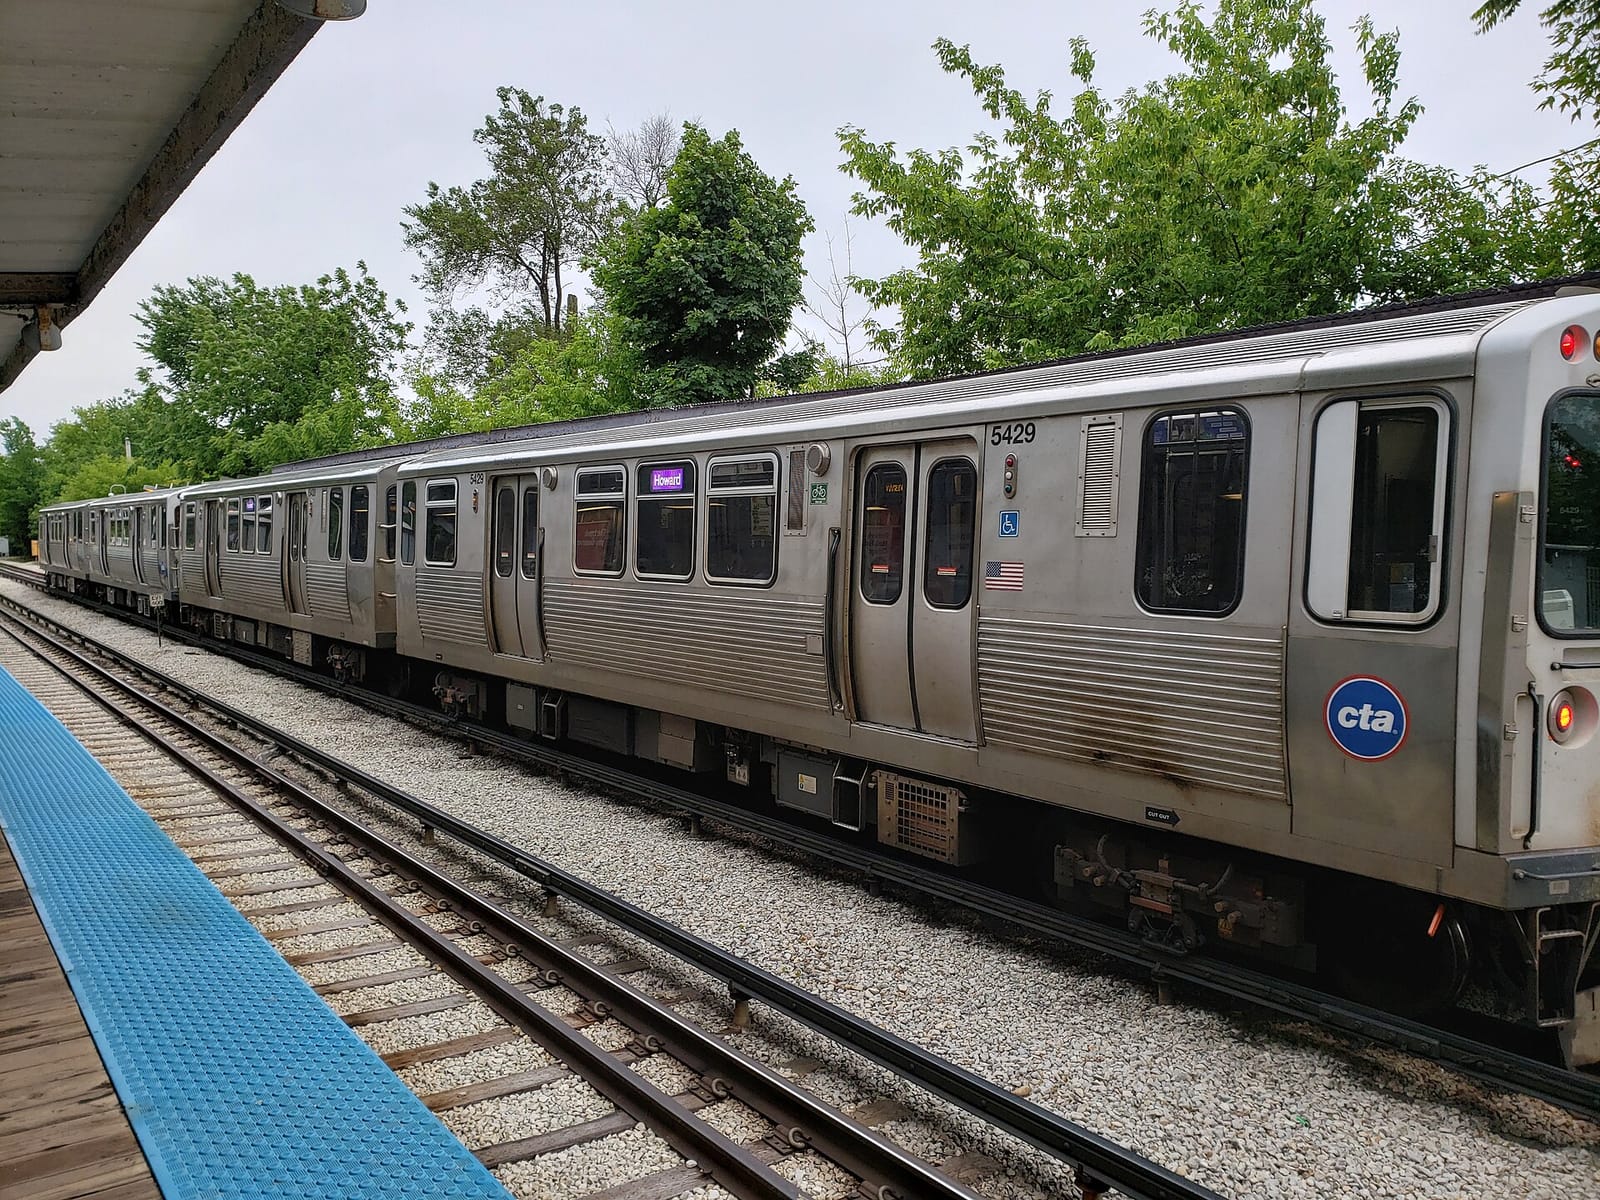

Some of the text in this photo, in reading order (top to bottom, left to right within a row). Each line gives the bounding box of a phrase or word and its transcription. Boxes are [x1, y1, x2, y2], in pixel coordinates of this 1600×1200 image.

[991, 422, 1036, 446] 5429
[470, 472, 484, 485] 5429
[654, 472, 681, 486] Howard
[1337, 703, 1395, 734] cta
